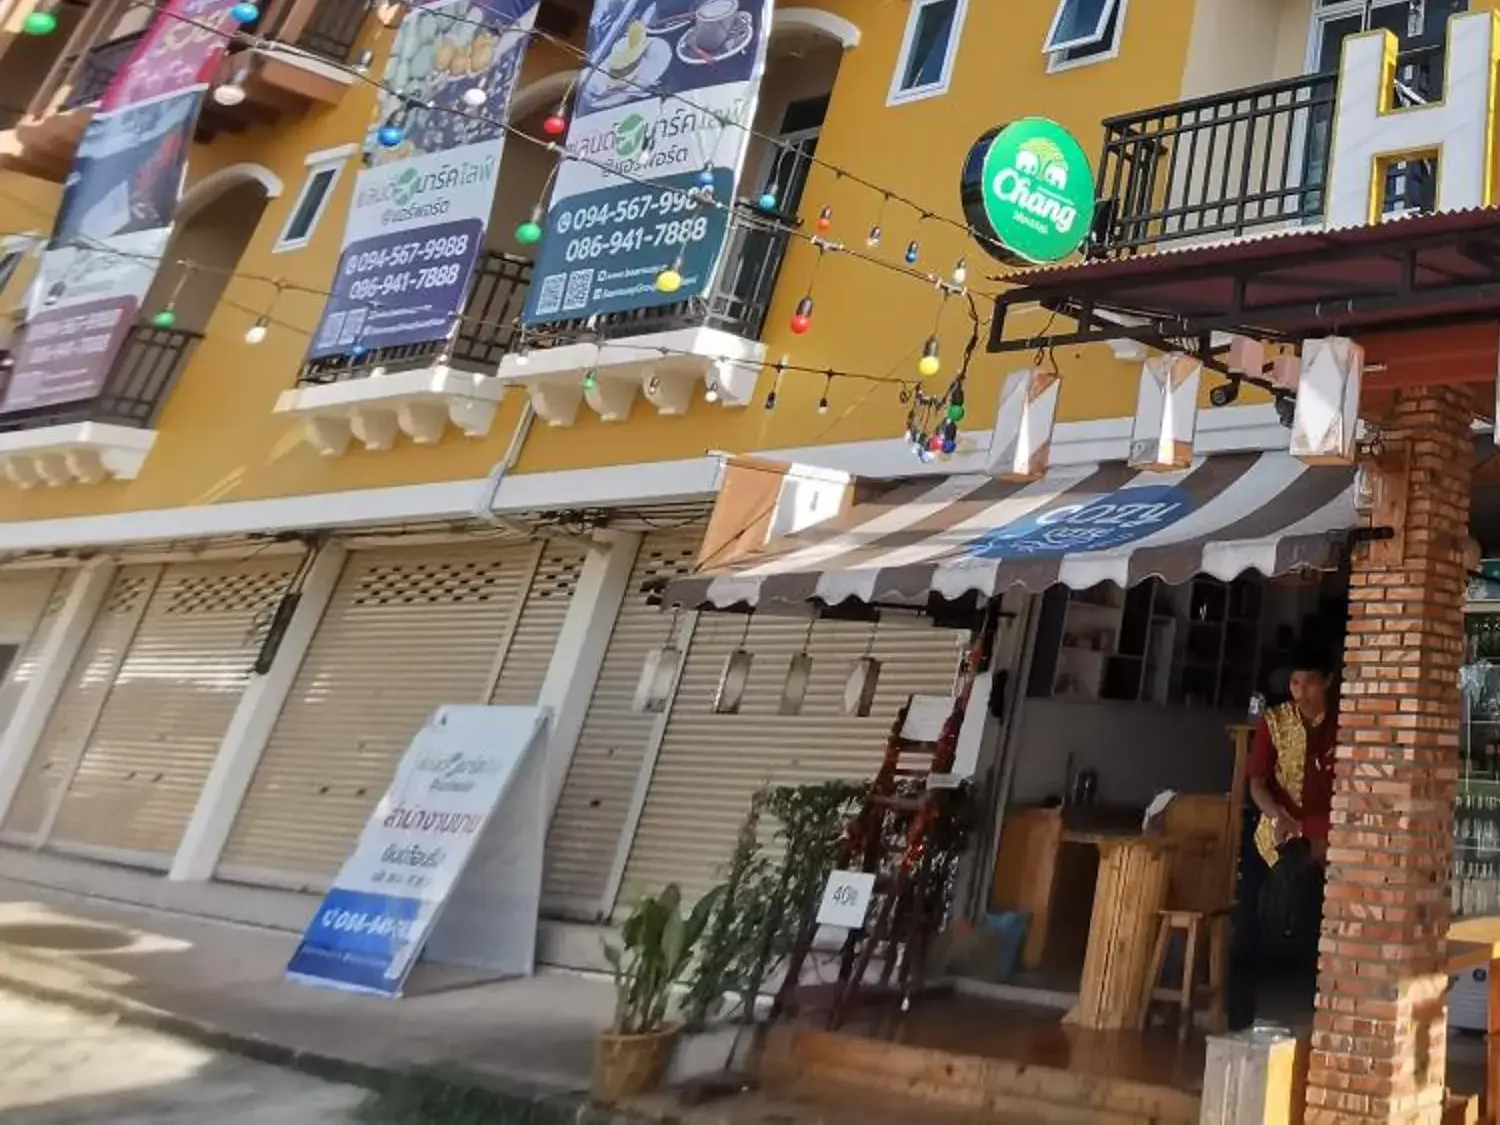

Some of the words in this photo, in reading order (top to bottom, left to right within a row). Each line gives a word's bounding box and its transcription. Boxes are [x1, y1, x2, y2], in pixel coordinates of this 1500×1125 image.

[991, 166, 1078, 234] Chang
[356, 234, 470, 272] 094-567-9988
[565, 216, 708, 263] 086-941-7888
[347, 262, 460, 301] 086-941-7888
